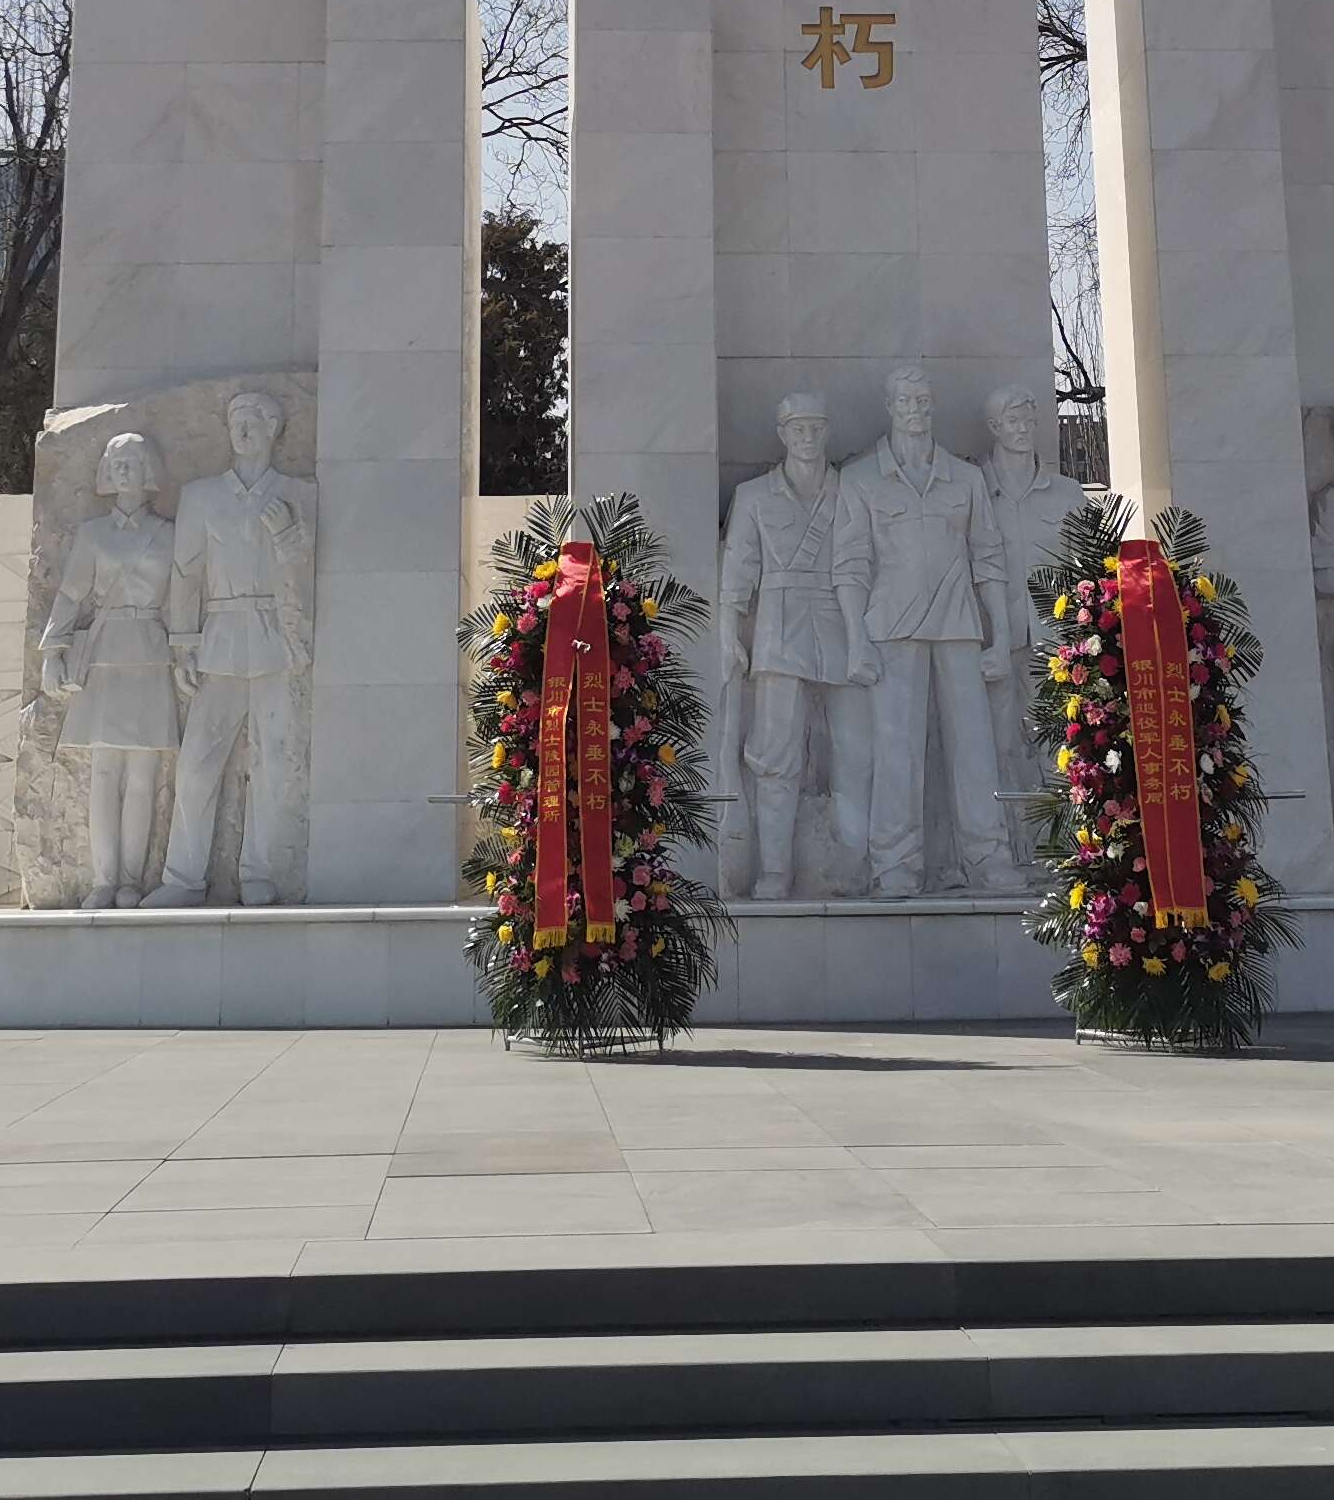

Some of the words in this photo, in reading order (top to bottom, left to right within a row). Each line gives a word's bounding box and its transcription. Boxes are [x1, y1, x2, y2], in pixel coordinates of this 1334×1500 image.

[542, 675, 567, 822] 银川市烈士陵园管理所
[583, 672, 607, 811] 烈士永垂不朽
[1131, 659, 1164, 804] 银川市退役军人事务局
[1166, 661, 1192, 801] 烈士永垂不朽
